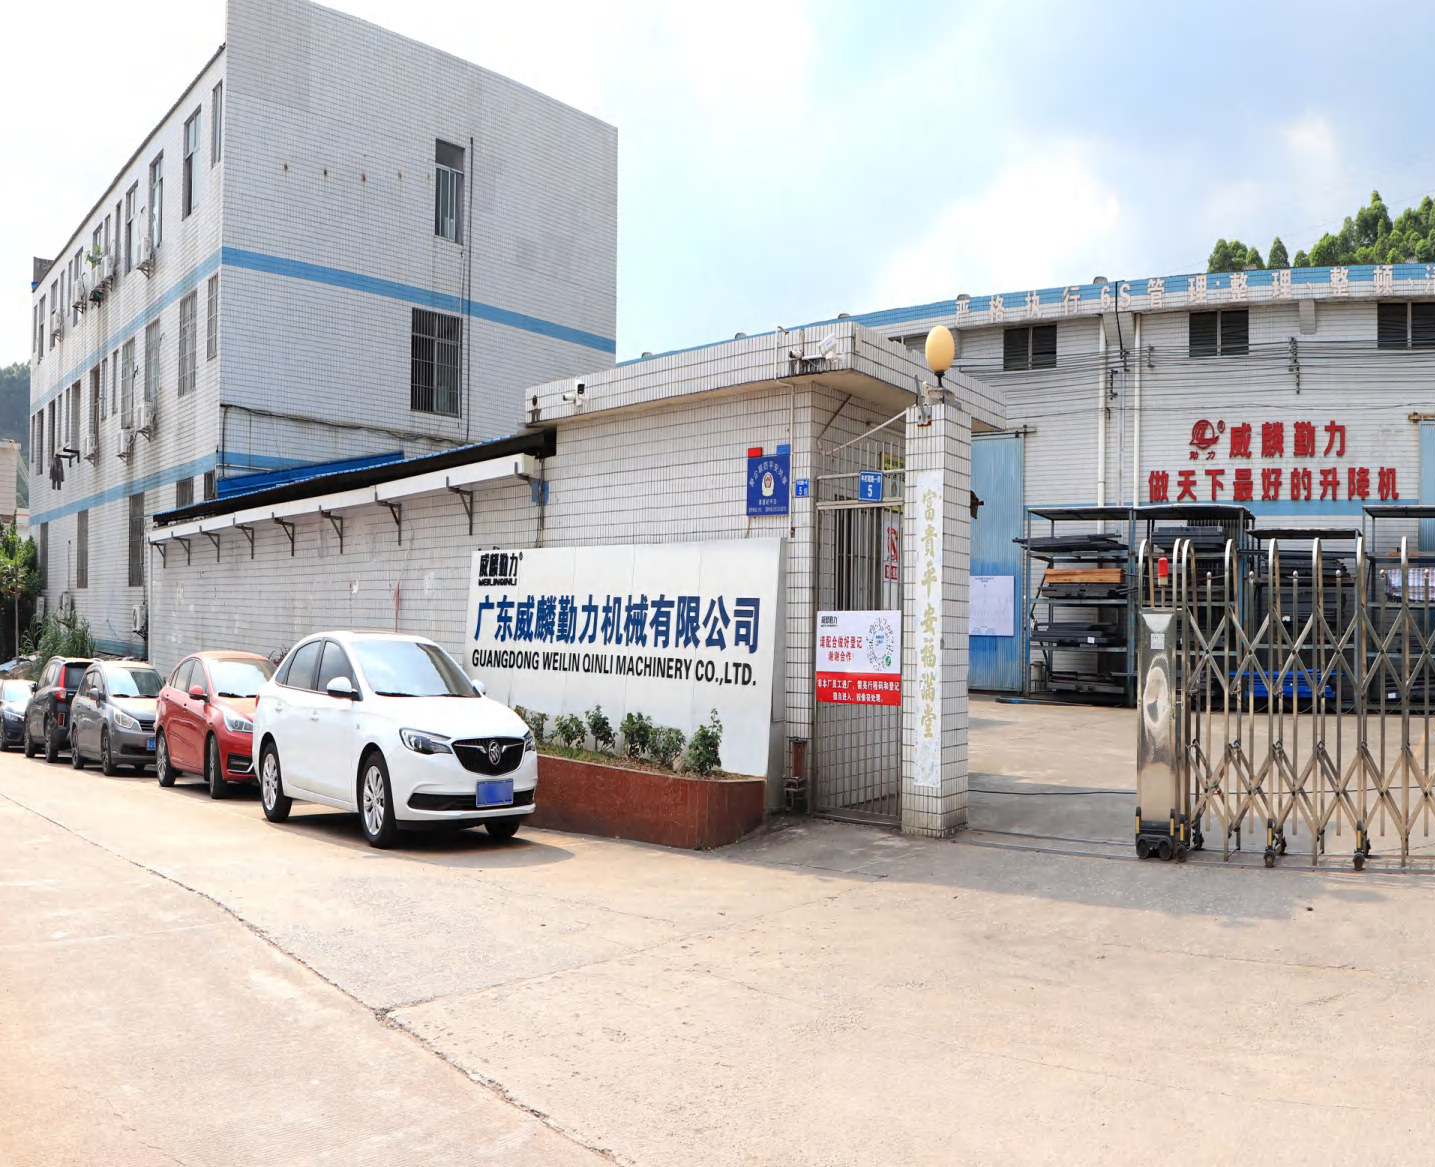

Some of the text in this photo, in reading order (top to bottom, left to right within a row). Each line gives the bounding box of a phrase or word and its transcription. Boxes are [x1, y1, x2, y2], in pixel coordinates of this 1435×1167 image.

[1229, 420, 1346, 458] 威麟勤力
[1148, 466, 1400, 502] 做天下最好的升降机
[474, 594, 761, 654] 广东威麟勤力机械有限公司
[471, 649, 757, 686] GUANGDONG WEILIN QINLI MACHINERY CO.,LTD.
